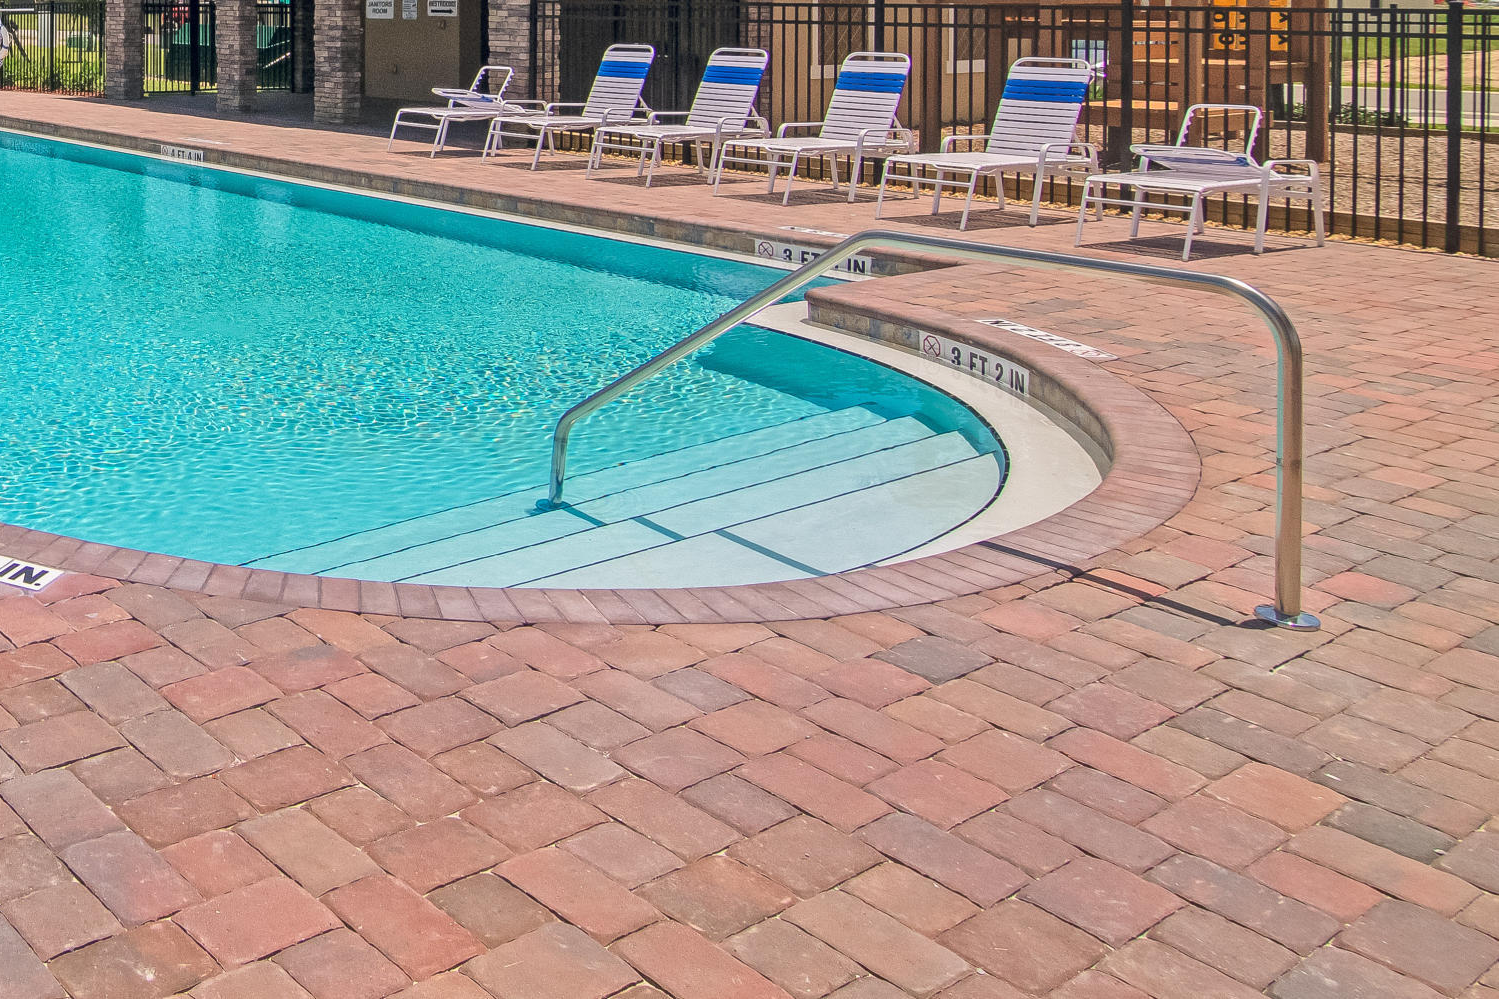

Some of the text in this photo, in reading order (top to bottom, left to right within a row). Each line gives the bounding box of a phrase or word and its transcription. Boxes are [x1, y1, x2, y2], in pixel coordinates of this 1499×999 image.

[177, 149, 185, 159] FT
[194, 152, 202, 162] IN
[782, 248, 793, 262] 3
[847, 258, 866, 274] IN
[951, 346, 1025, 394] 3 FT 2 IN
